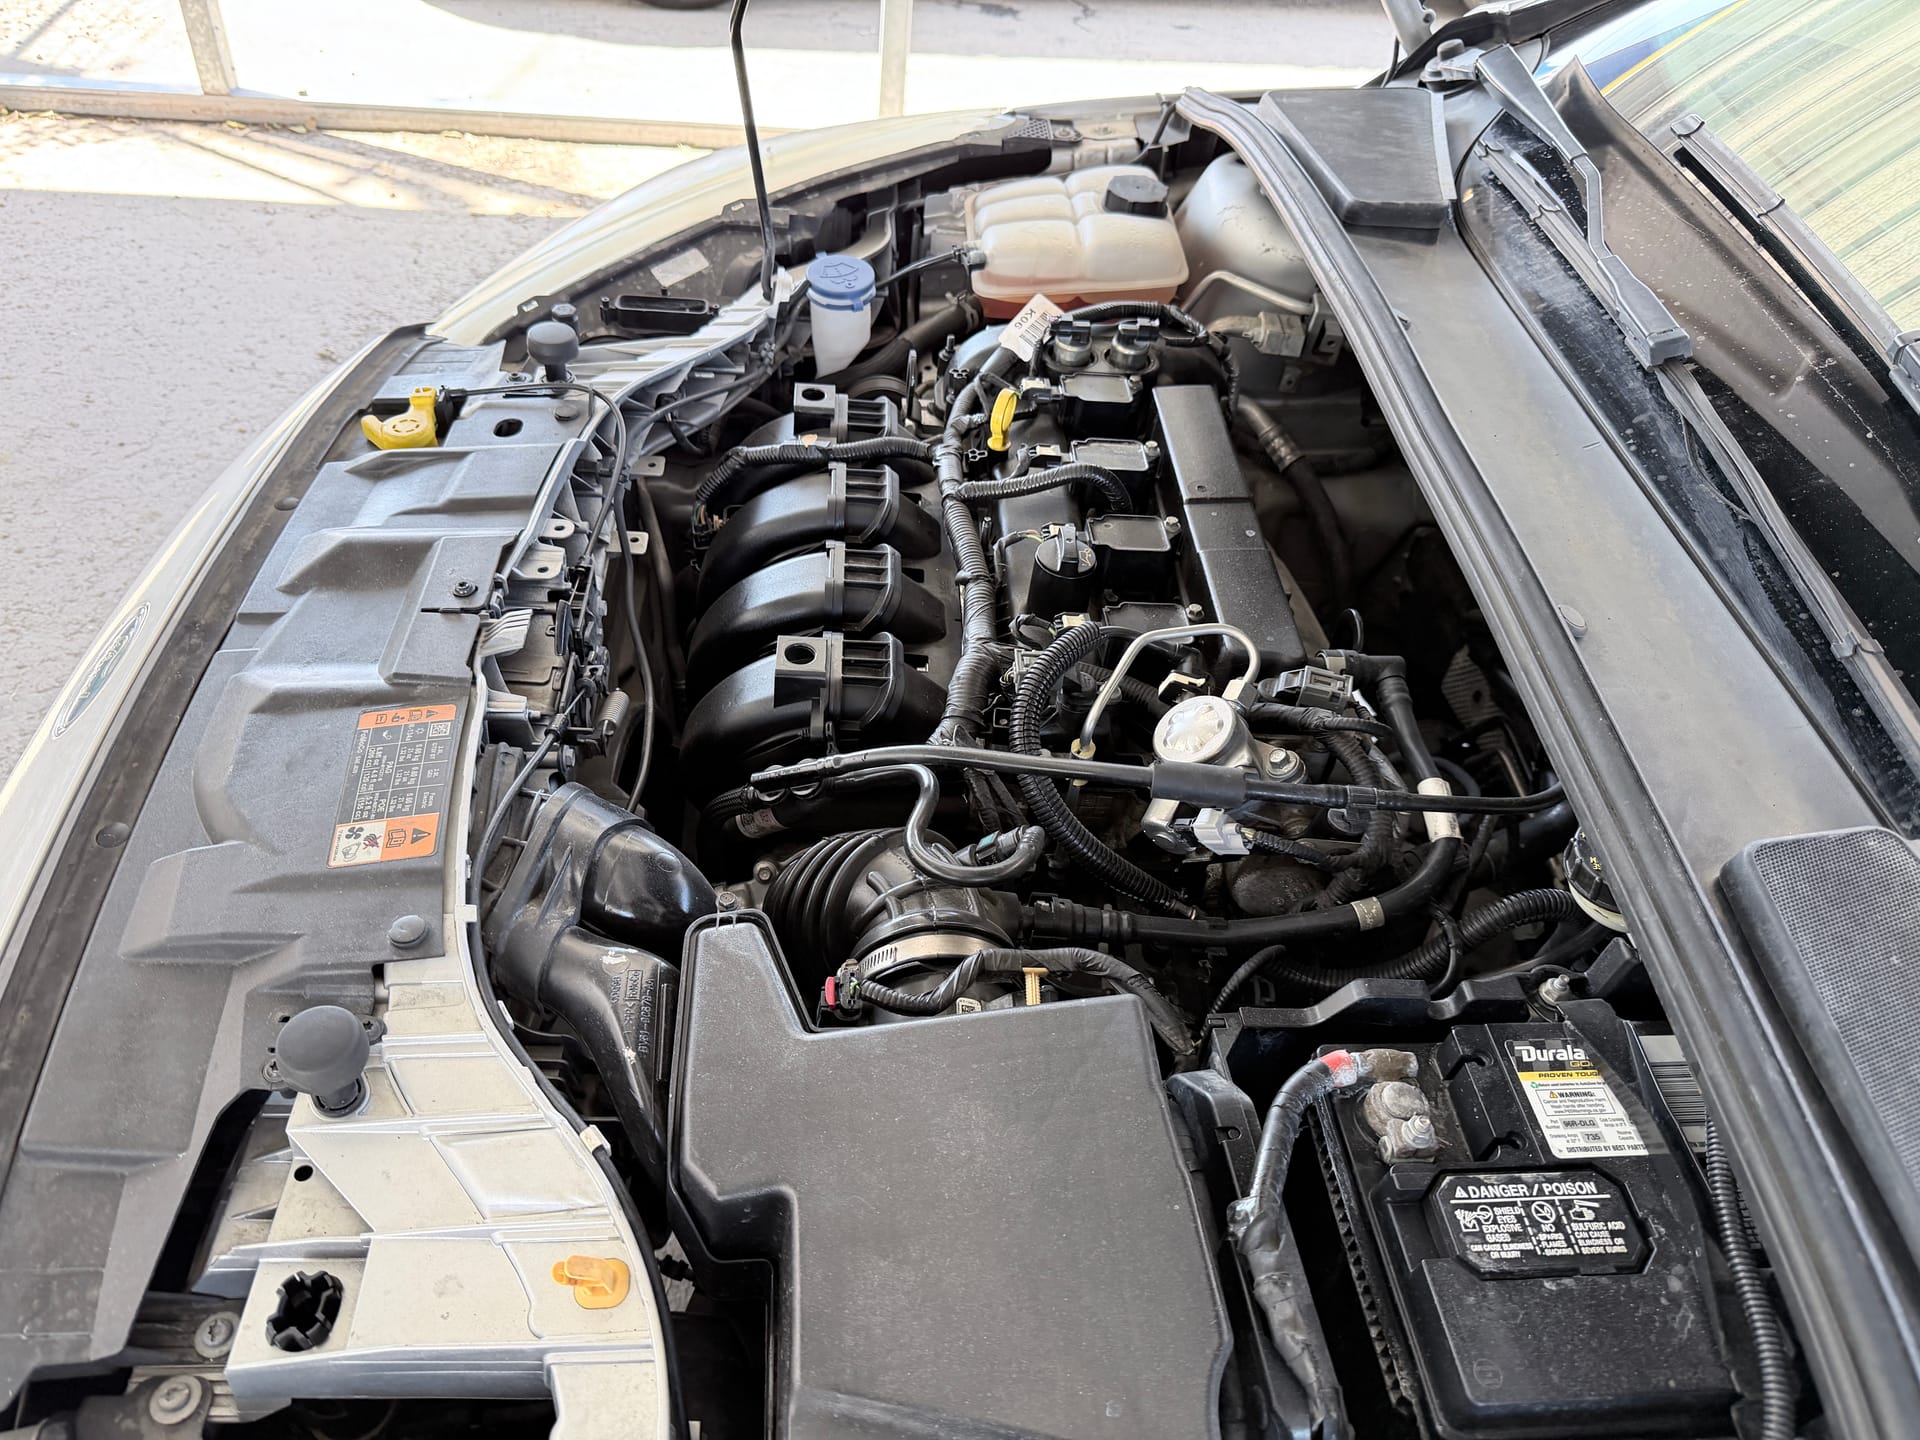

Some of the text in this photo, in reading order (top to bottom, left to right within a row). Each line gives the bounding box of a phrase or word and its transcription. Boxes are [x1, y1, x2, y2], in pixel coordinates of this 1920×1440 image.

[1514, 1045, 1589, 1062] Durala
[1566, 1145, 1602, 1153] DISTRIBUTED
[1468, 1184, 1530, 1198] DANGER
[1542, 1181, 1598, 1195] POISON
[1493, 1207, 1521, 1215] SHIELD
[1496, 1215, 1517, 1224] EYES
[1482, 1224, 1523, 1233] EXPLOSIVE
[1541, 1223, 1556, 1232] NO
[1571, 1221, 1626, 1231] SULFURIC ACID
[1485, 1233, 1511, 1242] GASES
[1589, 1230, 1611, 1238] CAUSE
[1483, 1243, 1502, 1251] CAUSE
[1502, 1242, 1534, 1250] BLINDNESS
[1578, 1238, 1613, 1246] BLINDNESS
[1490, 1251, 1500, 1259] OR
